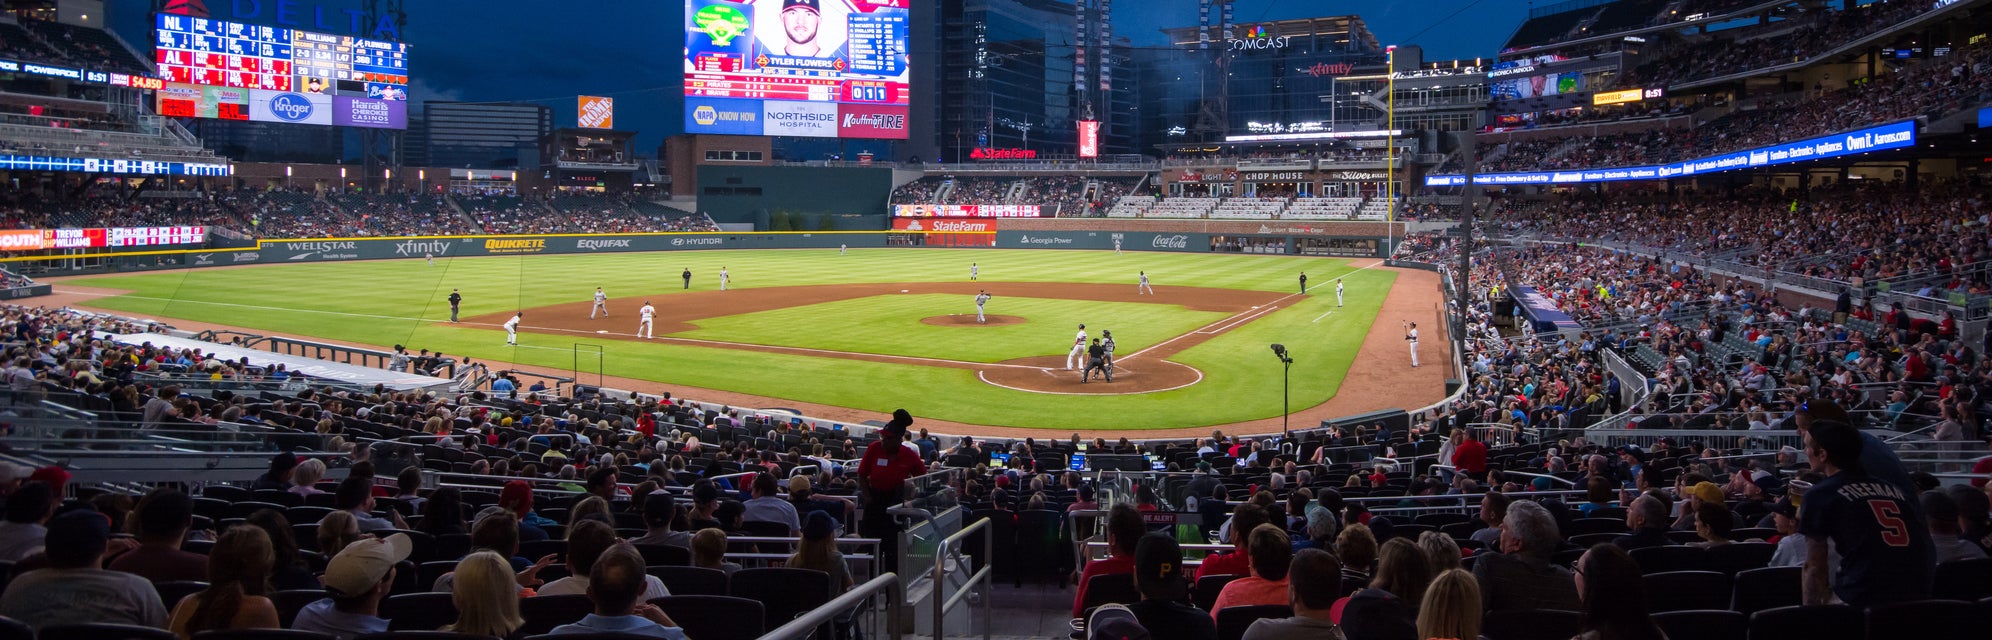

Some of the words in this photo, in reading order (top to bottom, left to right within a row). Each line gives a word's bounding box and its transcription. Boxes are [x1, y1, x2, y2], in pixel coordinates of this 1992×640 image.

[164, 16, 183, 30] NL
[231, 0, 398, 38] DELTA
[295, 31, 304, 40] P
[306, 34, 336, 43] WILLIAMS
[365, 41, 392, 49] FLOWERS
[165, 50, 184, 64] AL
[770, 57, 794, 66] TYLER
[796, 59, 832, 67] FLOWERS
[1308, 62, 1353, 77] xfinity
[1513, 66, 1534, 74] MINOLTA
[88, 74, 106, 82] 8:51
[132, 78, 162, 89] $4,850
[854, 88, 861, 98] 0
[867, 89, 873, 98] 1
[878, 89, 884, 99] 1
[1645, 89, 1662, 98] 8:51
[275, 96, 309, 118] Kroger
[352, 99, 388, 110] Harrah's
[579, 97, 612, 127] HOME
[697, 111, 713, 120] NAPA
[719, 112, 738, 121] KNOW
[740, 113, 755, 121] HOW
[768, 112, 834, 121] NORTHSIDE
[843, 114, 882, 127] Kauffman
[874, 115, 903, 129] TIRE
[1847, 136, 1864, 150] Own
[1874, 131, 1910, 145] Aarons.com
[1790, 146, 1813, 158] Electronics
[1816, 142, 1843, 155] Appliances
[1342, 171, 1372, 180] Silver
[1631, 169, 1654, 179] Appliances
[56, 230, 83, 238] TREVOR
[43, 239, 56, 247] RHP
[56, 238, 91, 247] WILLIAMS
[485, 239, 545, 249] QUIKRETE
[577, 240, 630, 250] EQUIFAX
[1030, 236, 1052, 244] Georgia
[287, 242, 355, 251] WELLSTAR
[396, 240, 450, 256] xfinity
[1837, 482, 1905, 501] FREEMAN
[1867, 499, 1910, 546] 5
[1160, 563, 1172, 577] P
